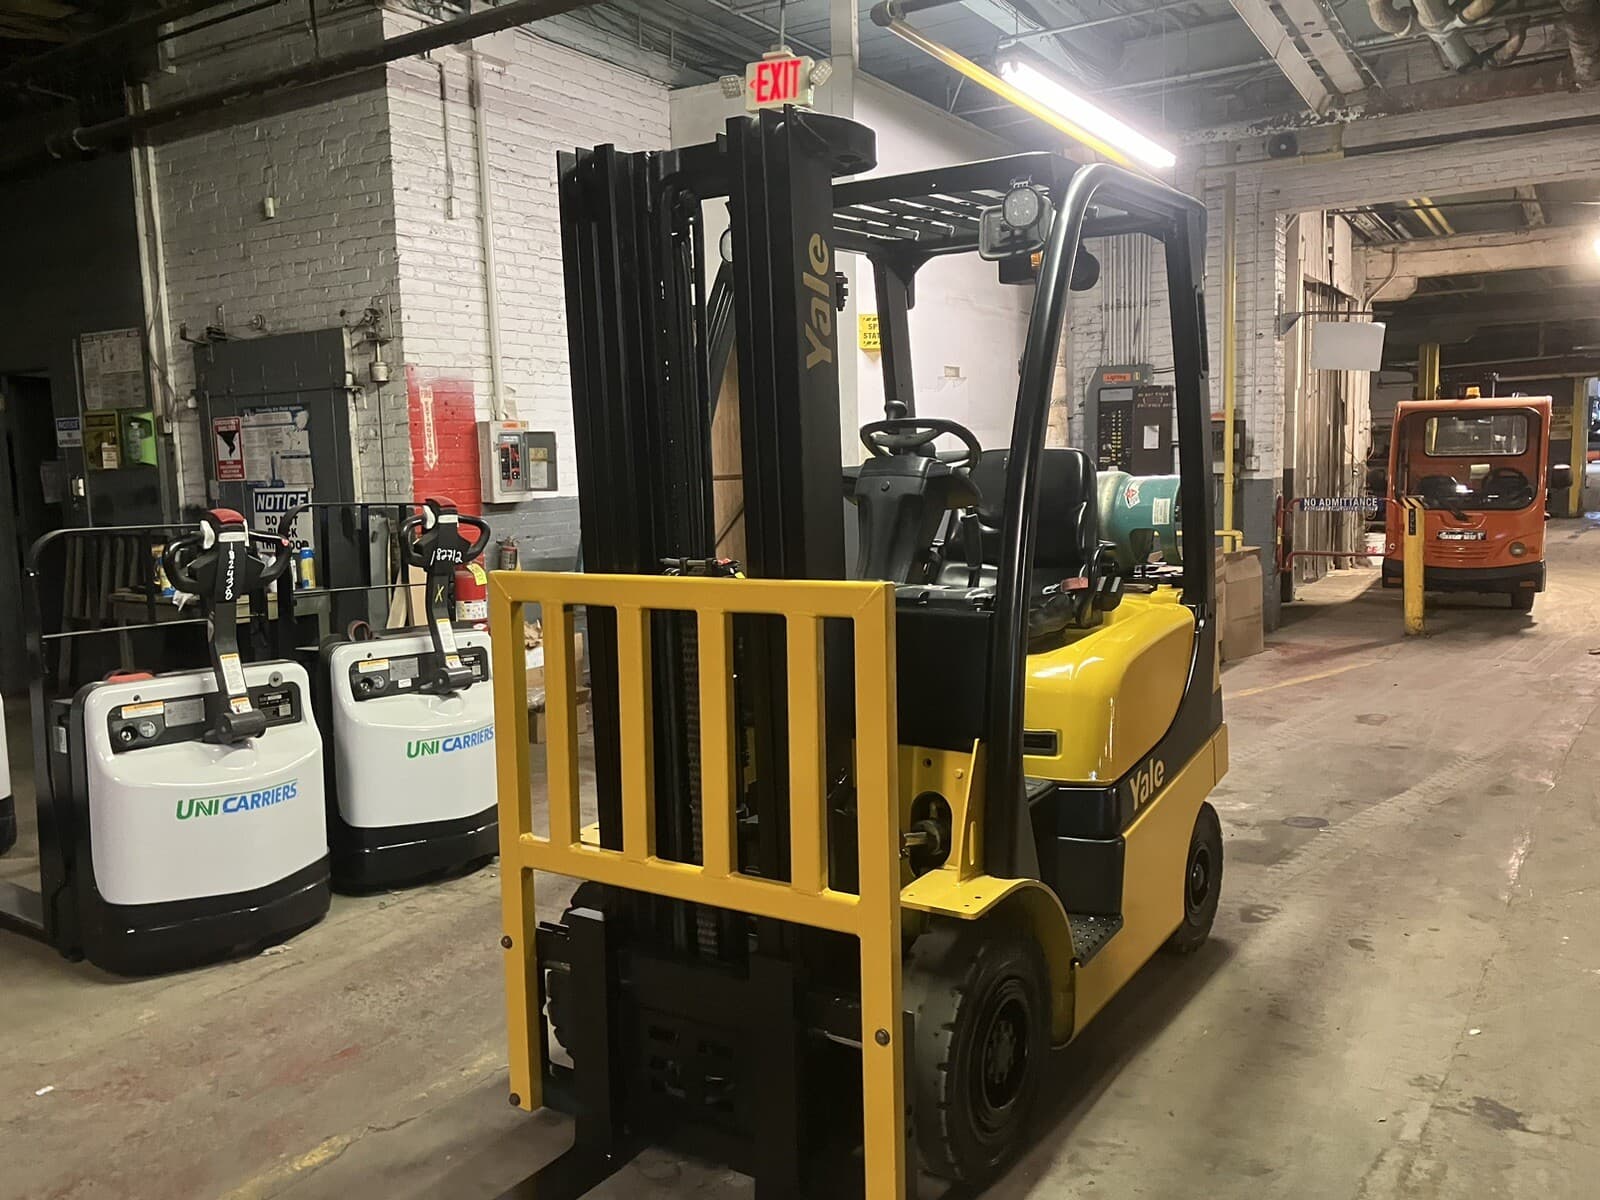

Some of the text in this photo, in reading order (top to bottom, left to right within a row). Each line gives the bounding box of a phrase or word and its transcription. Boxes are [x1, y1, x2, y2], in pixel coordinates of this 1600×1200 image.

[757, 60, 801, 102] EXIT
[803, 233, 832, 369] Yale
[256, 494, 306, 510] NOTICE
[1304, 497, 1378, 506] NO ADMITTANCE
[265, 516, 278, 525] DO
[1129, 758, 1164, 811] Yale
